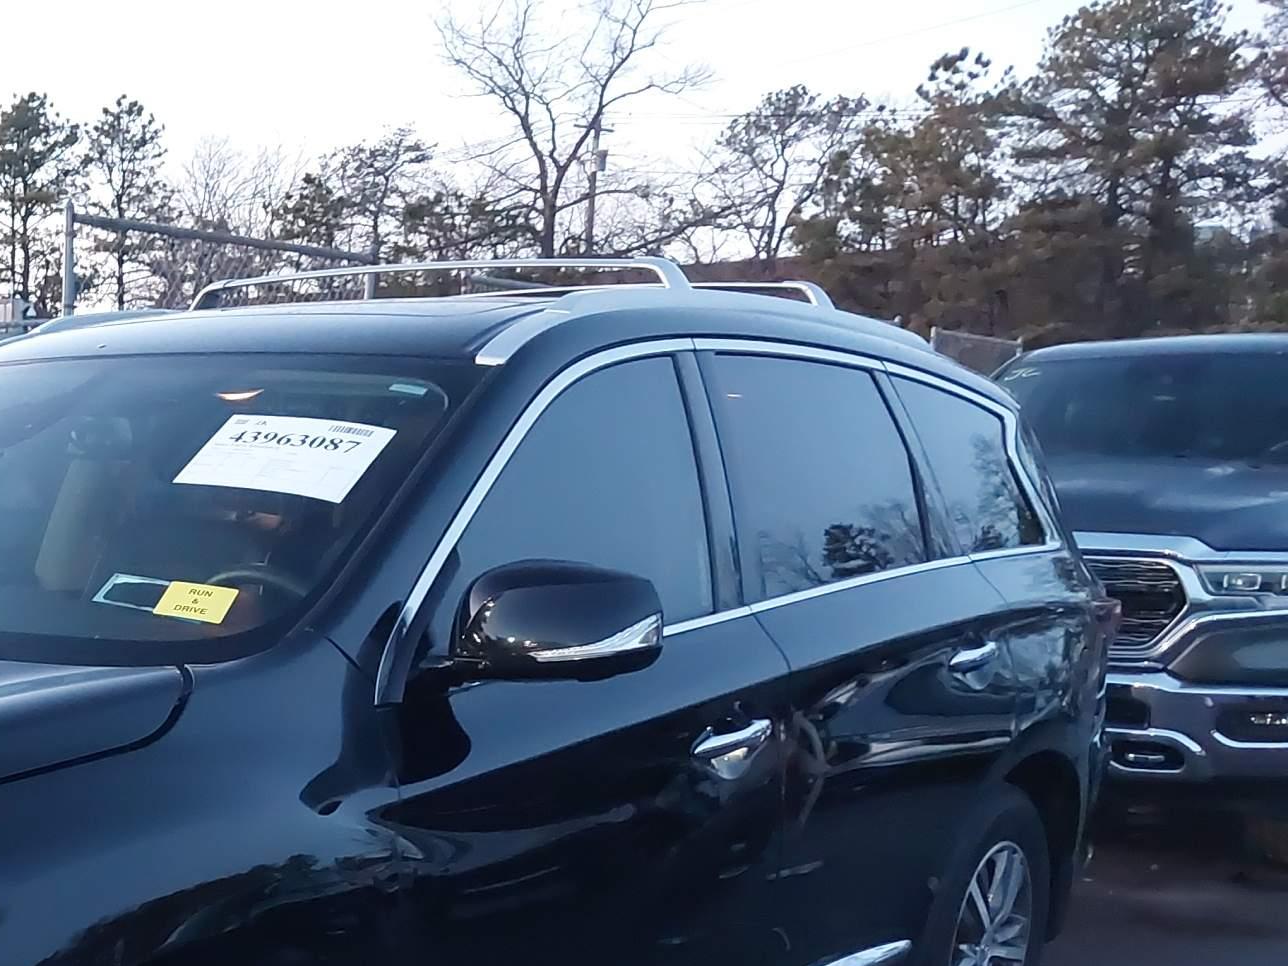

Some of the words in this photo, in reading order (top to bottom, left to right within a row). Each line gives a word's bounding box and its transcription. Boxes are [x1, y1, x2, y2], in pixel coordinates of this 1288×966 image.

[228, 430, 362, 453] 43963087
[188, 588, 214, 597] RUN
[173, 604, 208, 615] DRIVE
